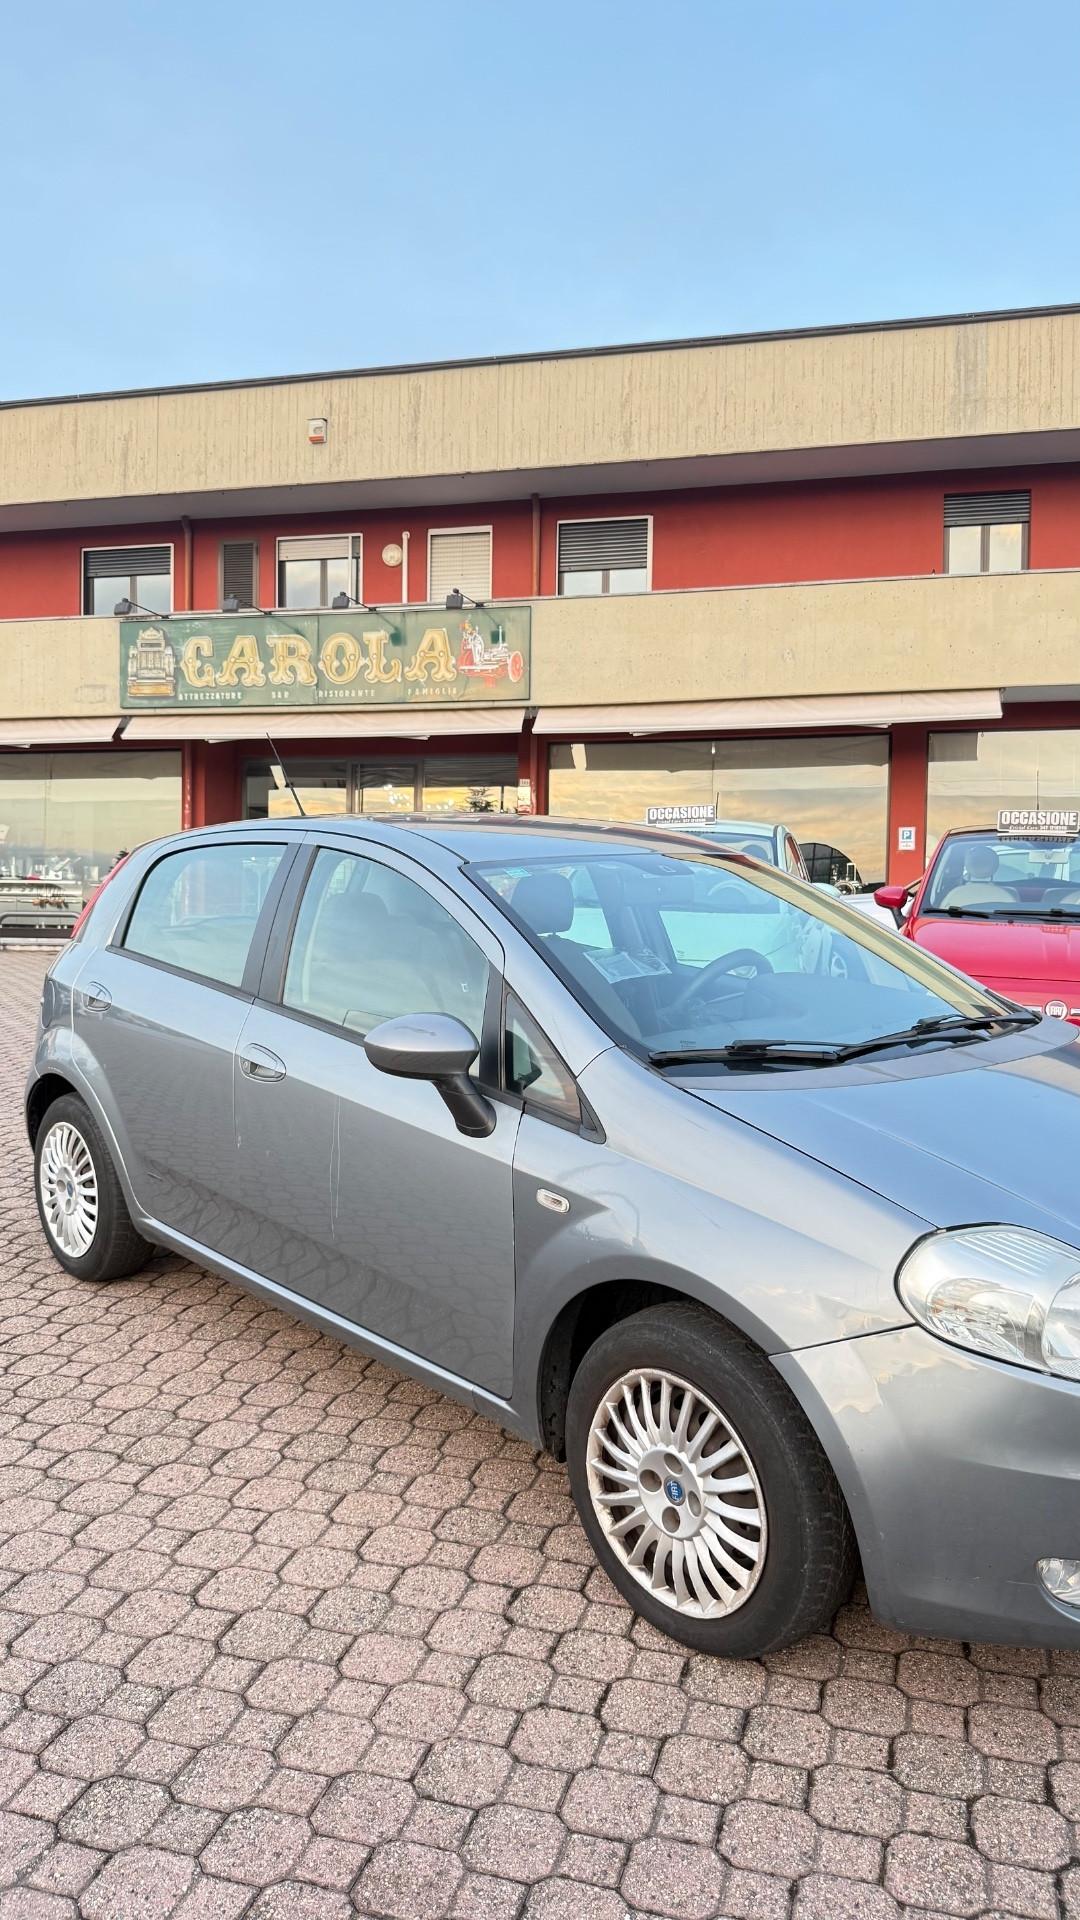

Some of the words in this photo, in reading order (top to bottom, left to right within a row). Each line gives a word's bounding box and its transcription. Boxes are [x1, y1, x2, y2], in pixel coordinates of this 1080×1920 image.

[179, 627, 458, 689] CAROLA
[178, 691, 243, 701] ATTREZZATURE
[318, 688, 375, 698] RISTORANTE
[649, 805, 714, 820] OCCASIONE
[1001, 811, 1077, 825] OCCASIONE
